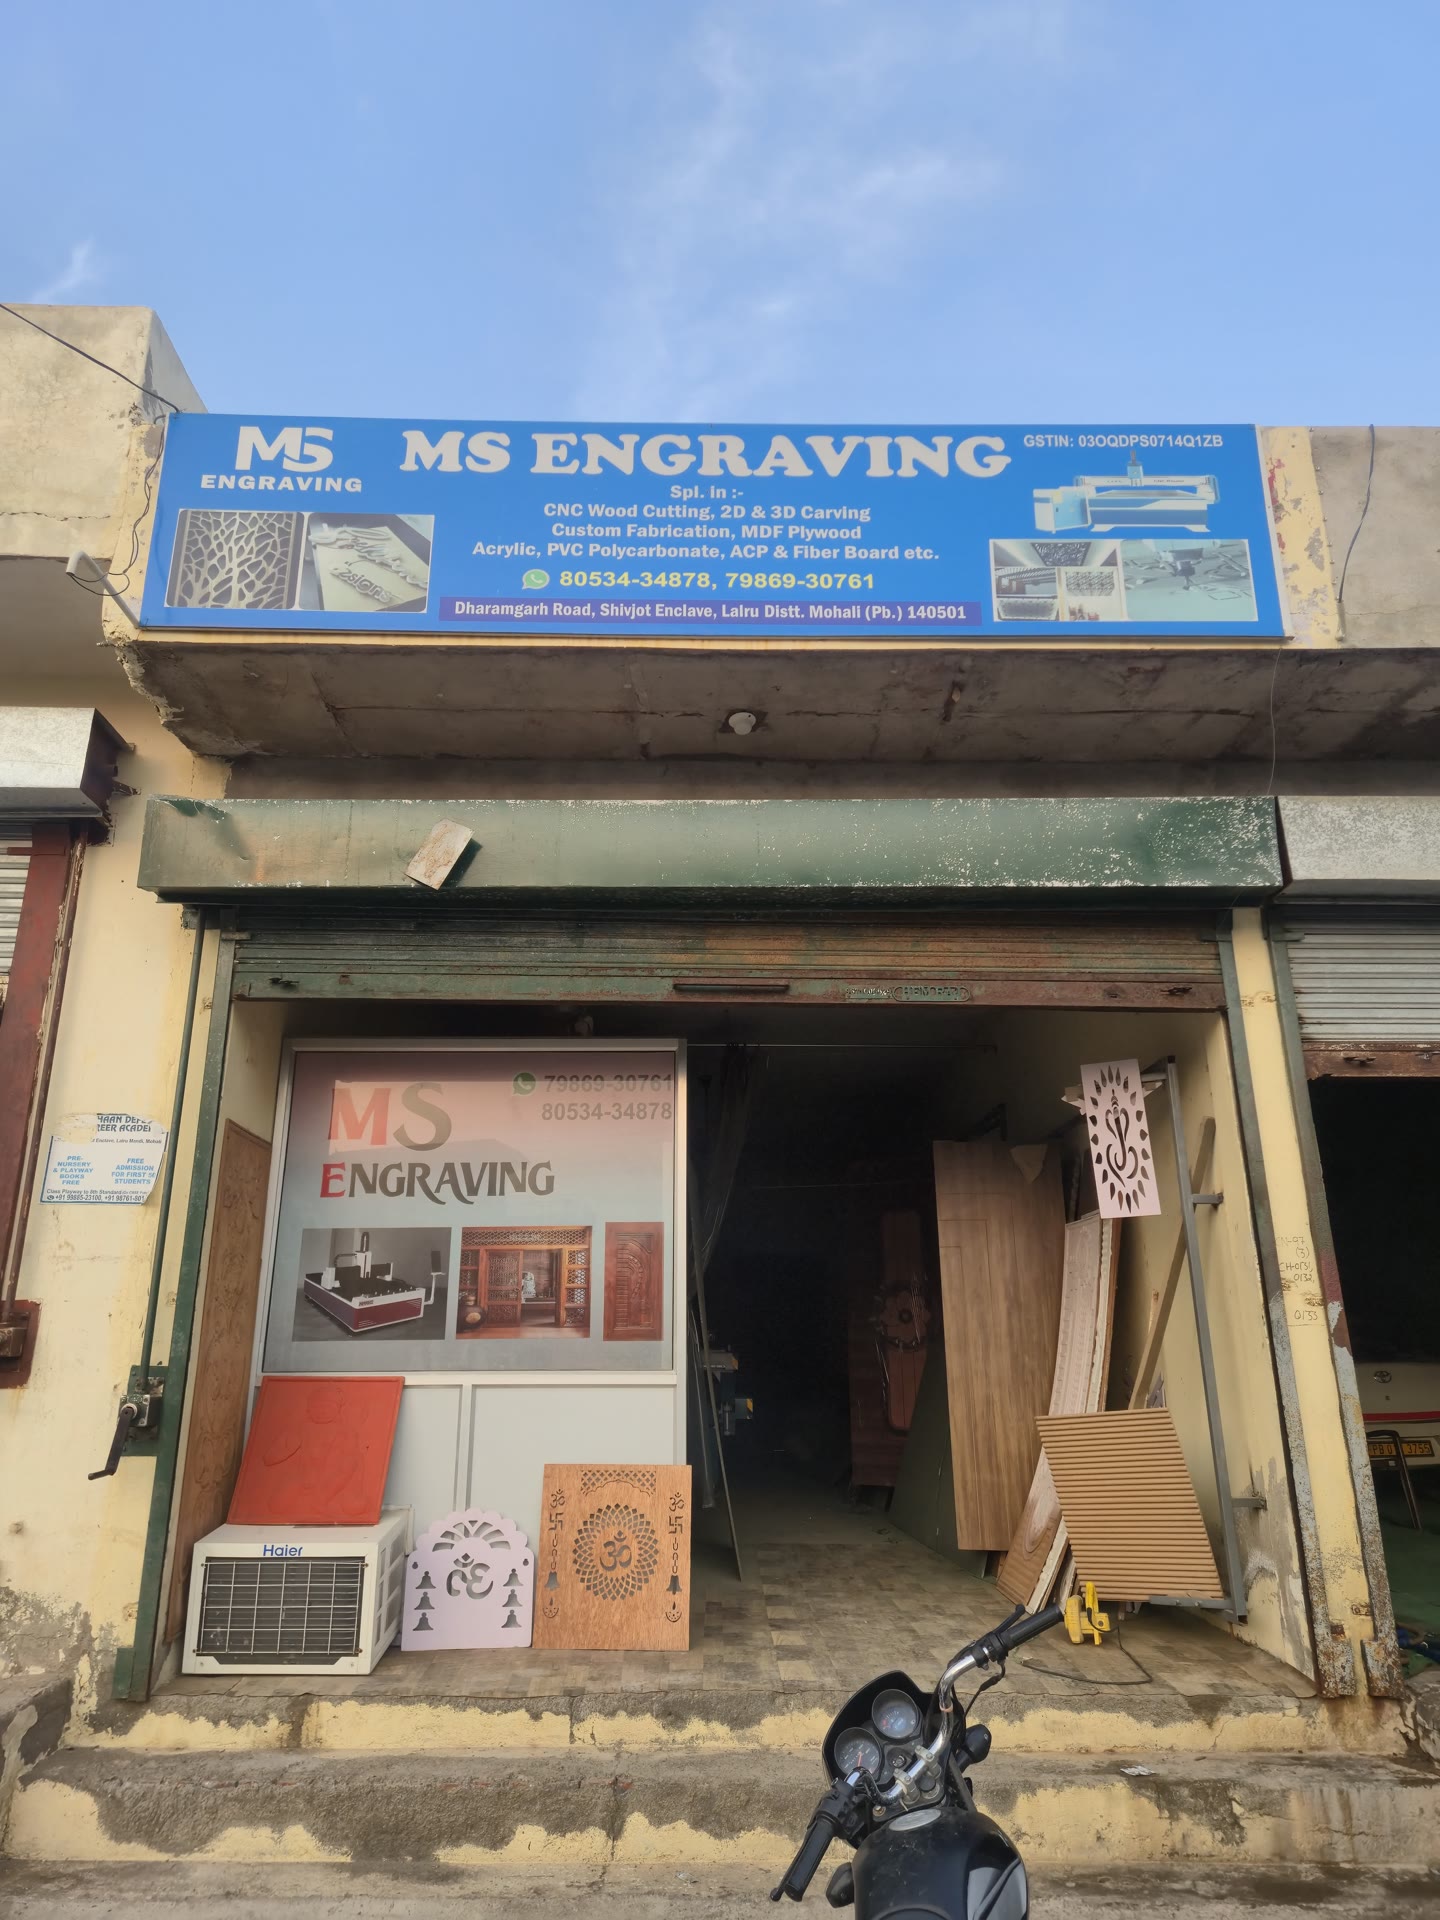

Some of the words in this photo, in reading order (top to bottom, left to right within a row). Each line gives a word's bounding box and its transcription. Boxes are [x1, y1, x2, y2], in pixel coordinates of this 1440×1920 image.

[235, 426, 334, 473] MS
[1024, 435, 1074, 447] GSTIN:
[400, 430, 511, 473] MS
[530, 433, 1012, 478] ENGRAVING
[201, 474, 362, 493] ENGRAVING
[670, 486, 705, 501] Spl.
[710, 486, 727, 499] in
[544, 503, 584, 517] CNC
[588, 504, 638, 518] Wood
[643, 504, 716, 521] Cutting,
[720, 505, 746, 519] 2D
[751, 505, 766, 519] &
[771, 505, 796, 520] 3D
[801, 506, 872, 522] Carving
[552, 523, 622, 538] Custom
[626, 524, 736, 541] Fabrication,
[741, 525, 784, 539] MDF
[788, 526, 862, 542] Plywood
[473, 542, 542, 559] Acrylic,
[547, 543, 584, 557] PVC
[589, 543, 726, 560] Polycarbonate,
[730, 545, 769, 559] ACP
[773, 546, 789, 560] &
[794, 546, 840, 560] Fiber
[844, 546, 899, 560] Board
[904, 547, 940, 560] etc.
[559, 571, 718, 590] 80534-34878,
[726, 573, 875, 589] 79869-30761
[455, 601, 549, 618] Dharamgarh
[553, 603, 596, 618] Road,
[600, 603, 652, 620] Shivjot
[655, 603, 718, 620] Enclave,
[722, 604, 760, 618] Lalru
[764, 605, 805, 619] Distt.
[809, 605, 861, 620] Mohali
[865, 605, 903, 622] (Pb.)
[907, 606, 967, 620] 140501
[544, 1074, 673, 1093] 79869-30761
[328, 1082, 452, 1152] MS
[541, 1102, 673, 1121] 80534-34878
[320, 1161, 556, 1206] ENGRAVING
[263, 1544, 304, 1557] Haier
